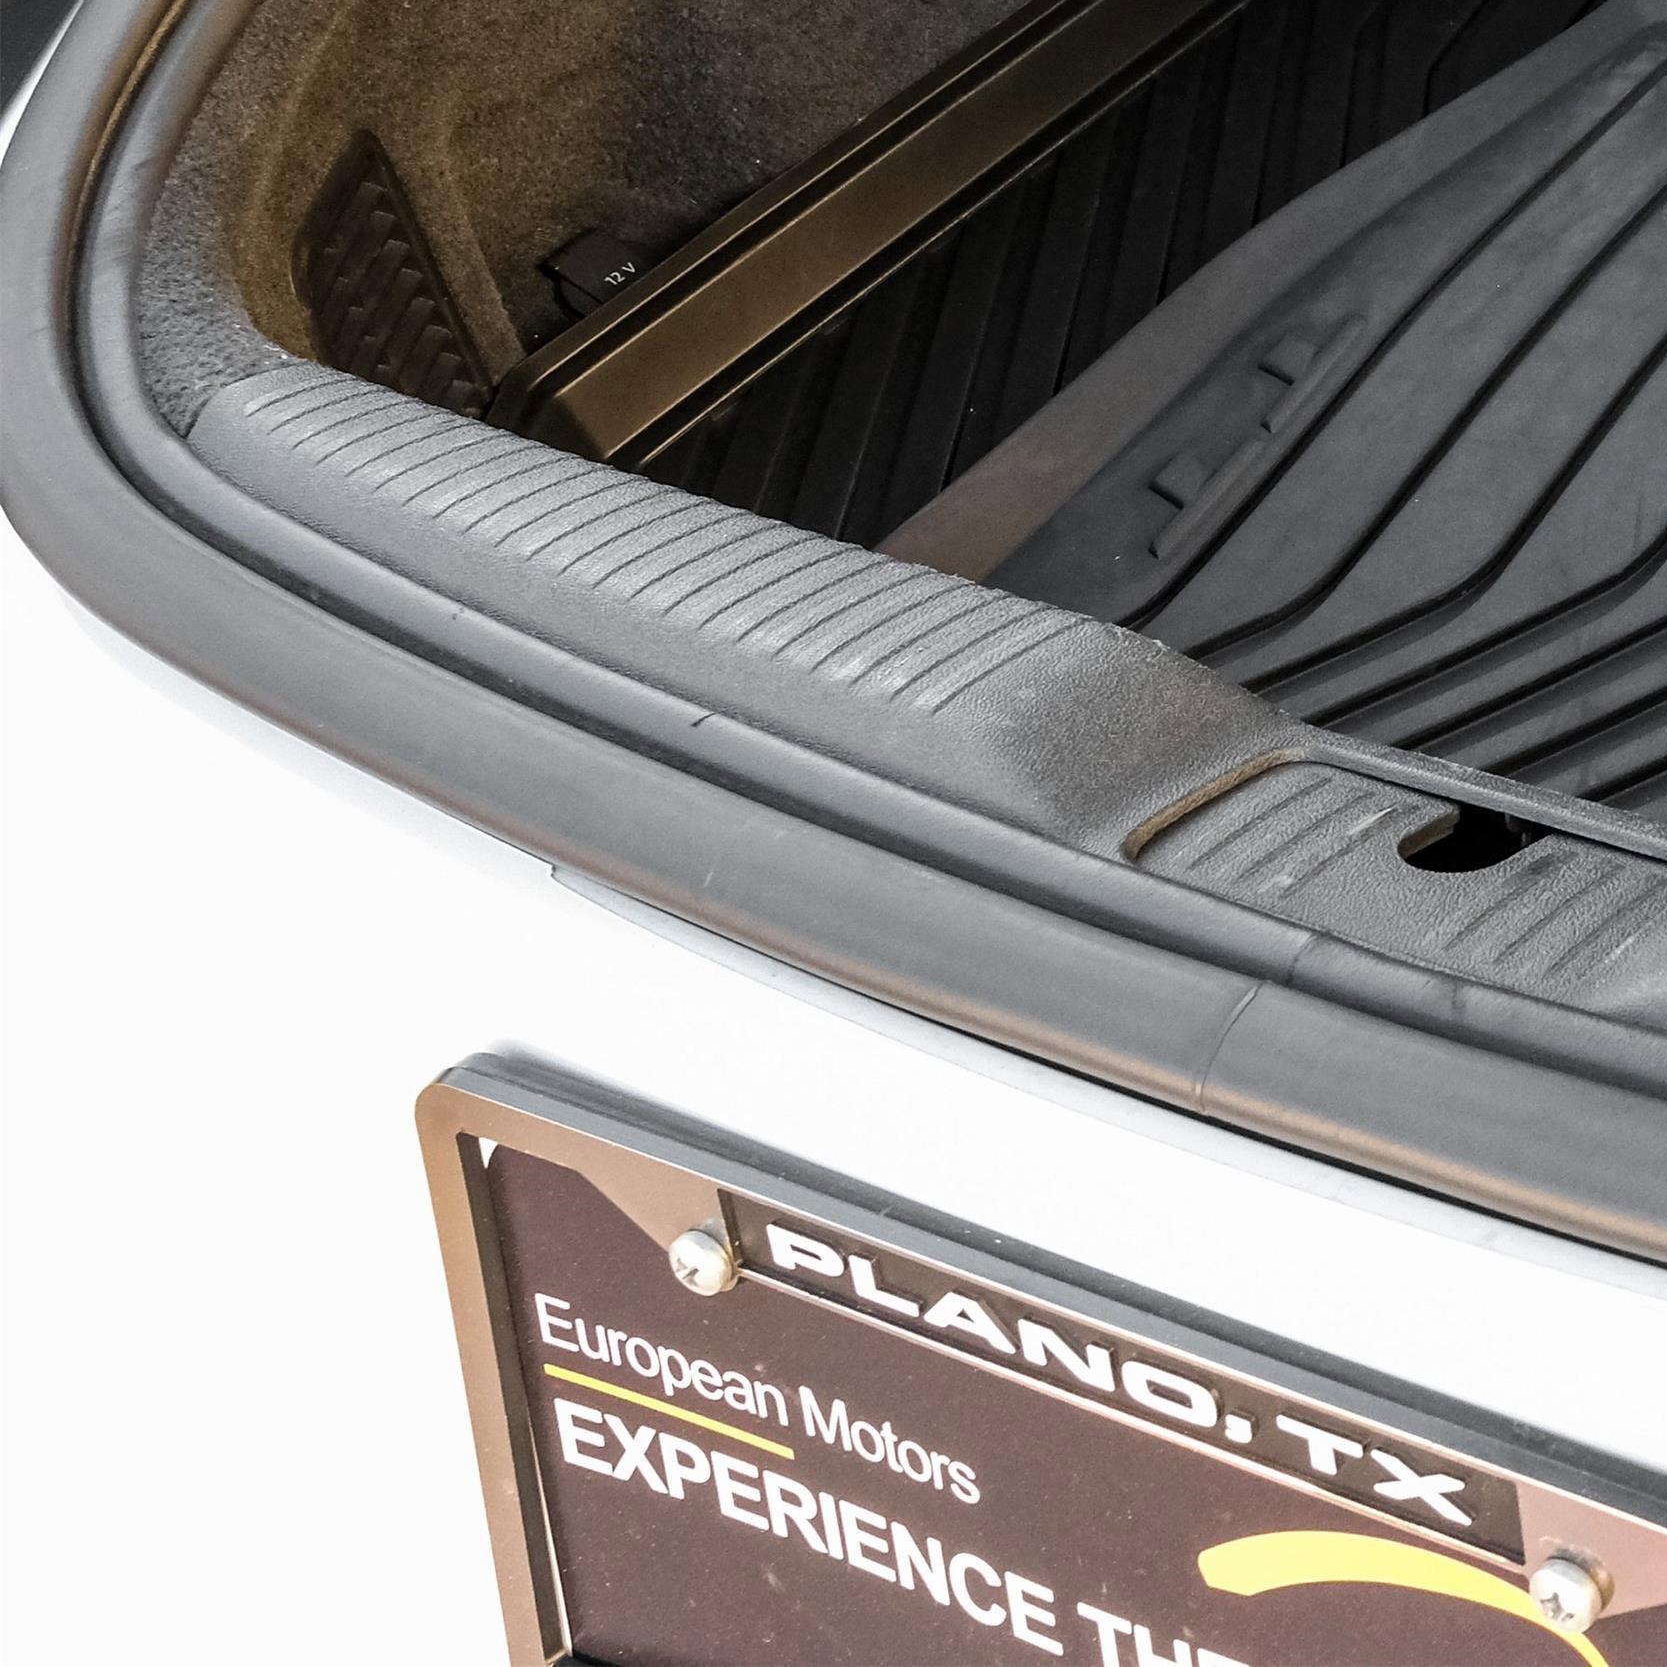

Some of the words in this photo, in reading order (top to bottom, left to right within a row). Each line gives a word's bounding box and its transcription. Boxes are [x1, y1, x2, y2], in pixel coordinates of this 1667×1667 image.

[604, 271, 626, 285] 12
[621, 261, 637, 274] V
[534, 1292, 789, 1427] European
[799, 1385, 981, 1504] Motors
[553, 1397, 1064, 1656] EXPERIENCE
[1076, 1601, 1251, 1667] TH
